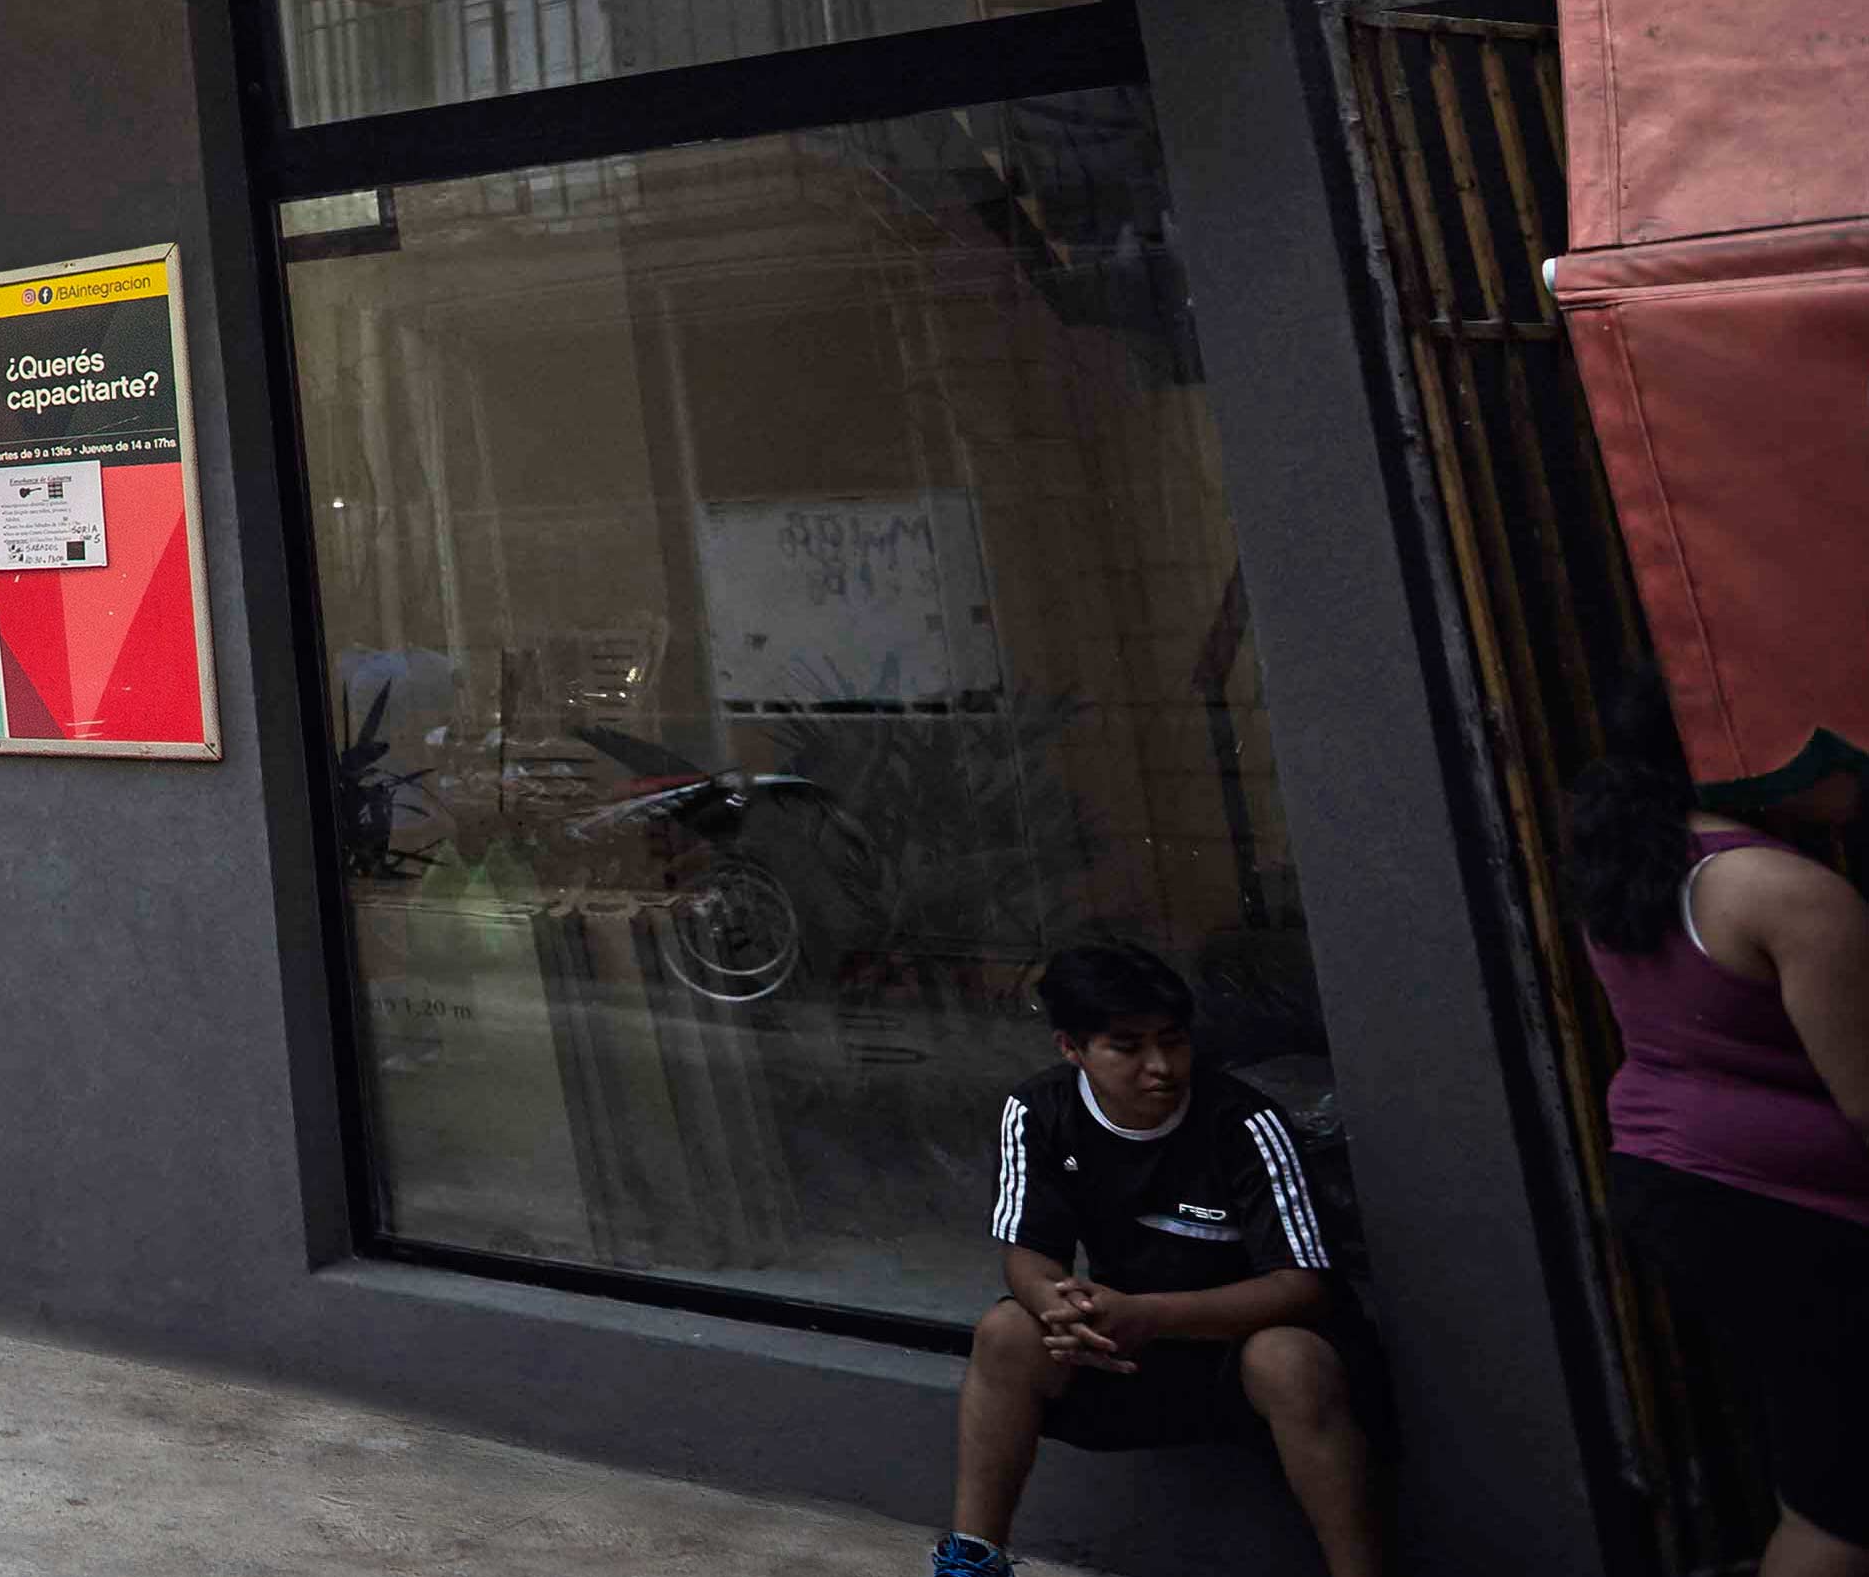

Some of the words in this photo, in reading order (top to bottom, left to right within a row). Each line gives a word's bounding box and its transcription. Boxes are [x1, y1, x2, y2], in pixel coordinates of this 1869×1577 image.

[5, 348, 105, 382] ¿Querés
[6, 371, 160, 414] capacitarte?
[20, 448, 33, 459] de
[35, 448, 41, 458] 9
[42, 449, 49, 457] a
[79, 442, 114, 456] Jueves
[115, 440, 129, 452] de
[131, 439, 143, 451] 14
[144, 441, 151, 450] a
[153, 437, 177, 450] 17hs
